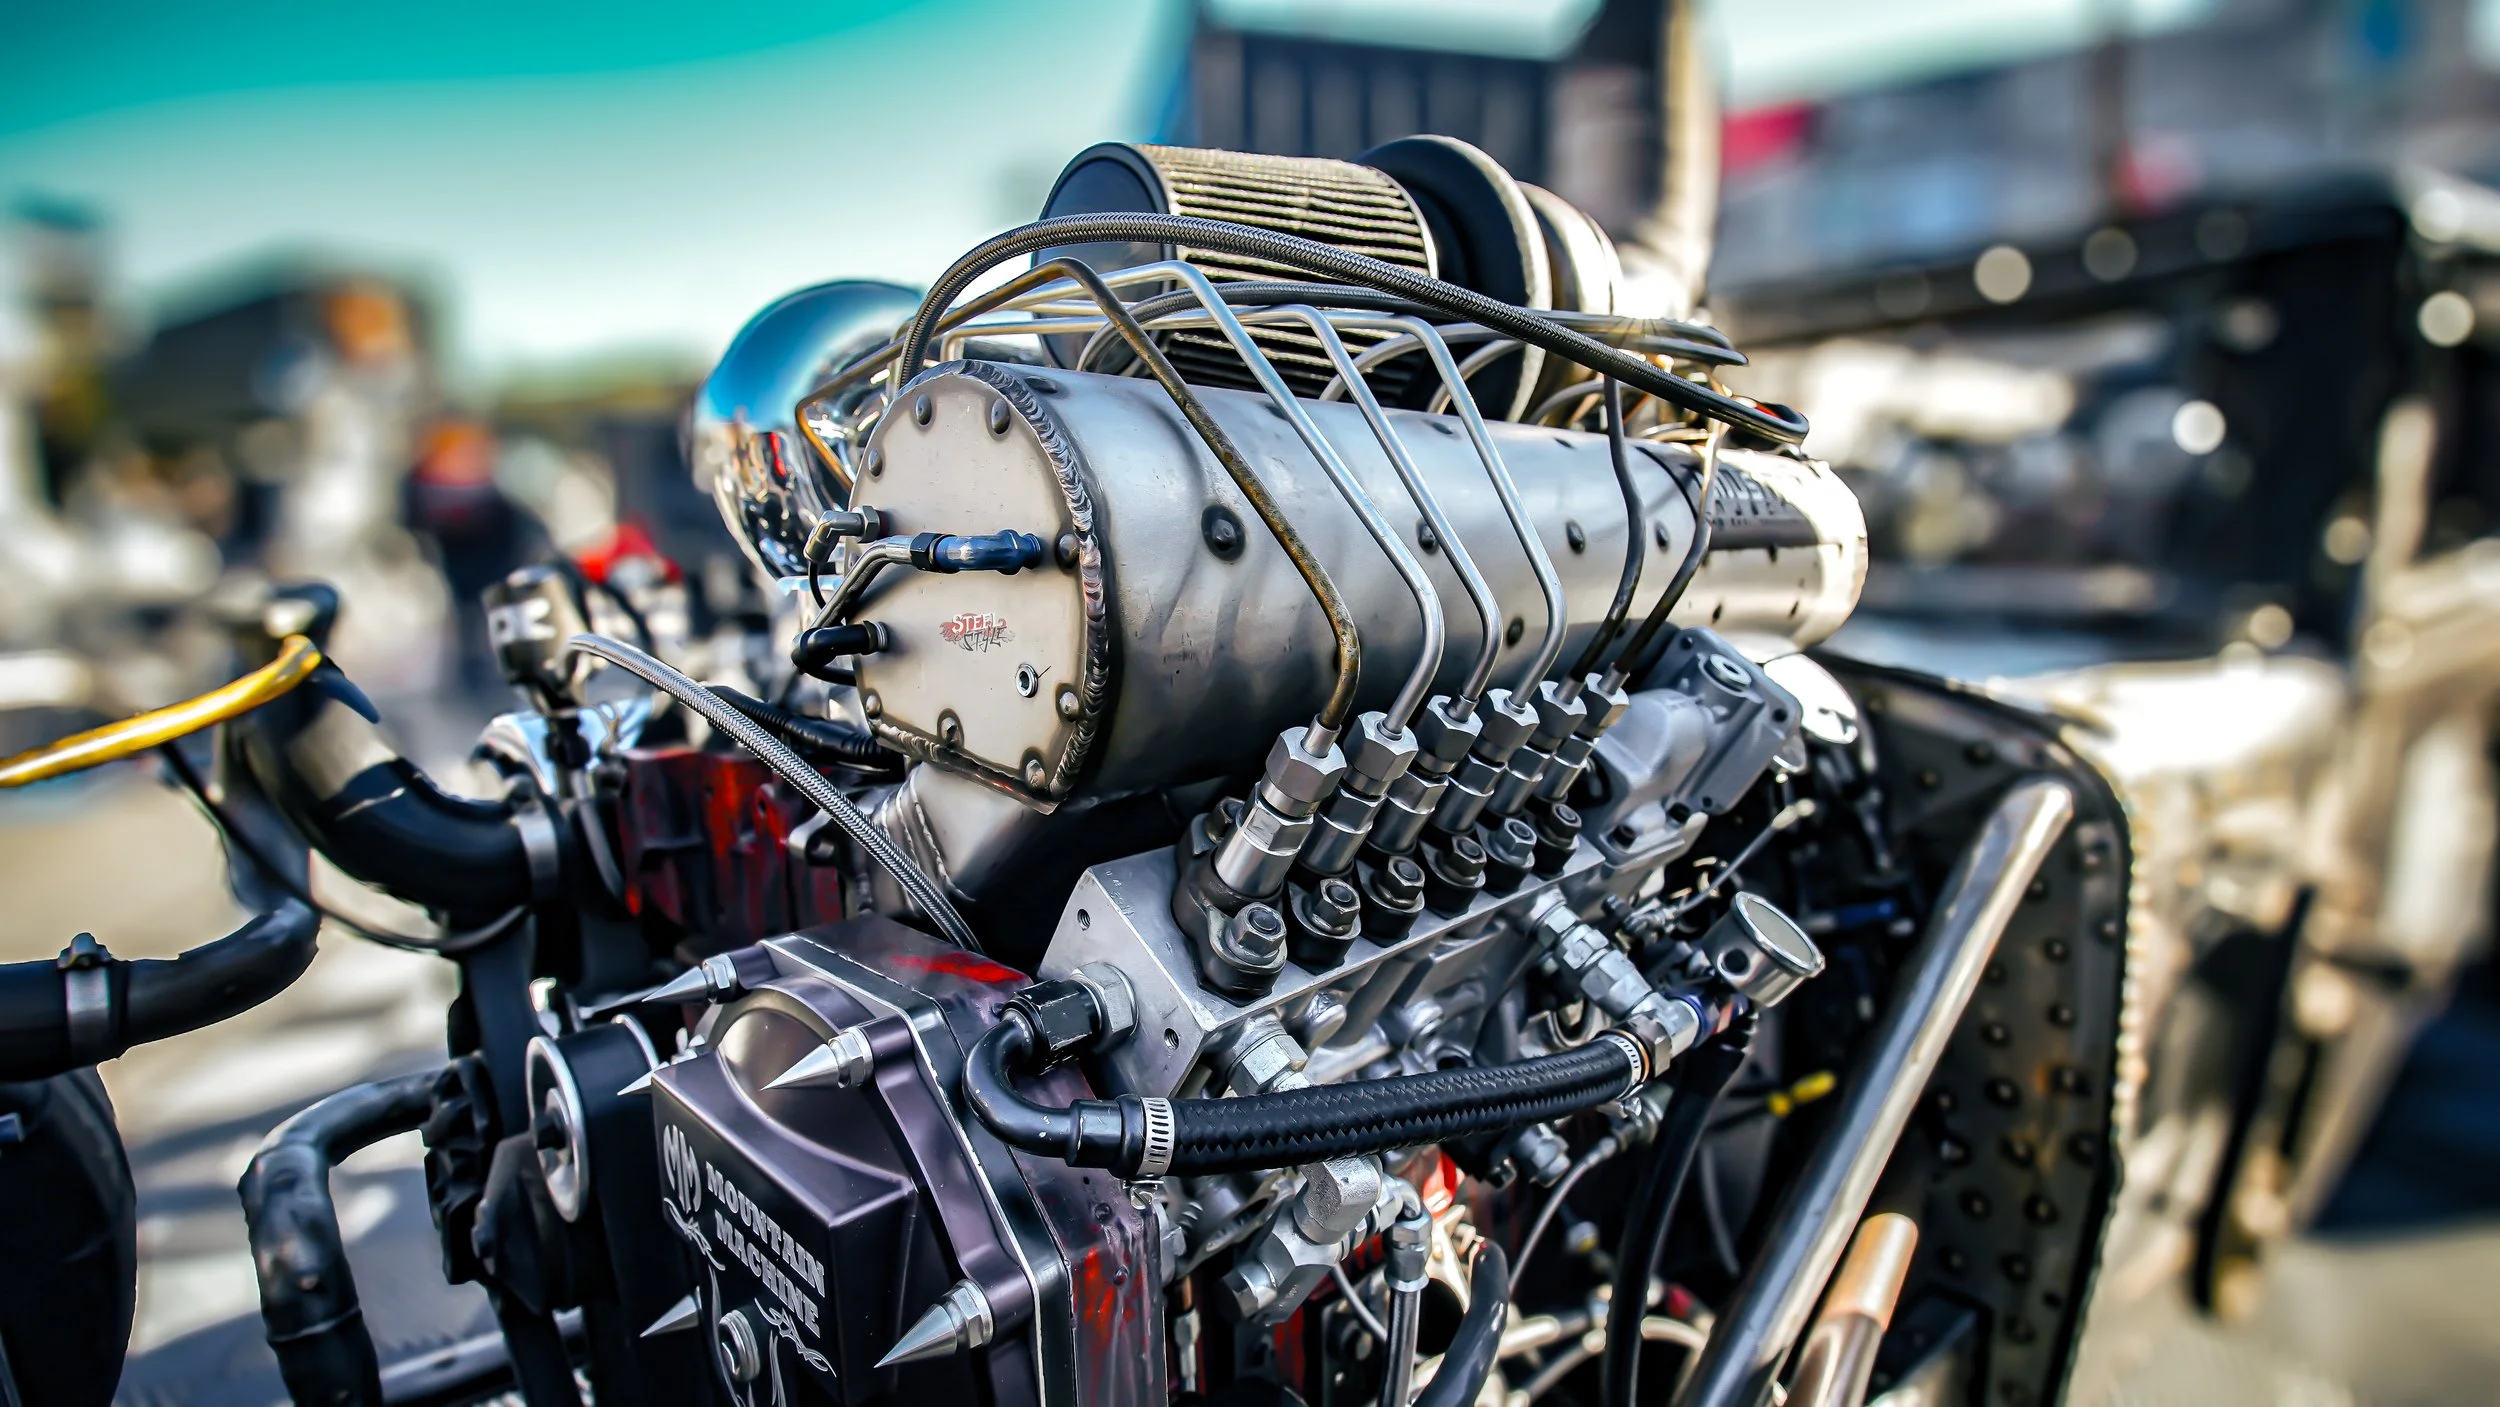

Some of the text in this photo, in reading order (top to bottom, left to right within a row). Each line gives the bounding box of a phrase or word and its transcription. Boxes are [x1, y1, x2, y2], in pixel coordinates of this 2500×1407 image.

[952, 612, 1003, 633] STEEL
[963, 626, 1007, 653] STYLE
[706, 1161, 826, 1298] MOUNTAIN
[715, 1209, 821, 1339] MACHINE
